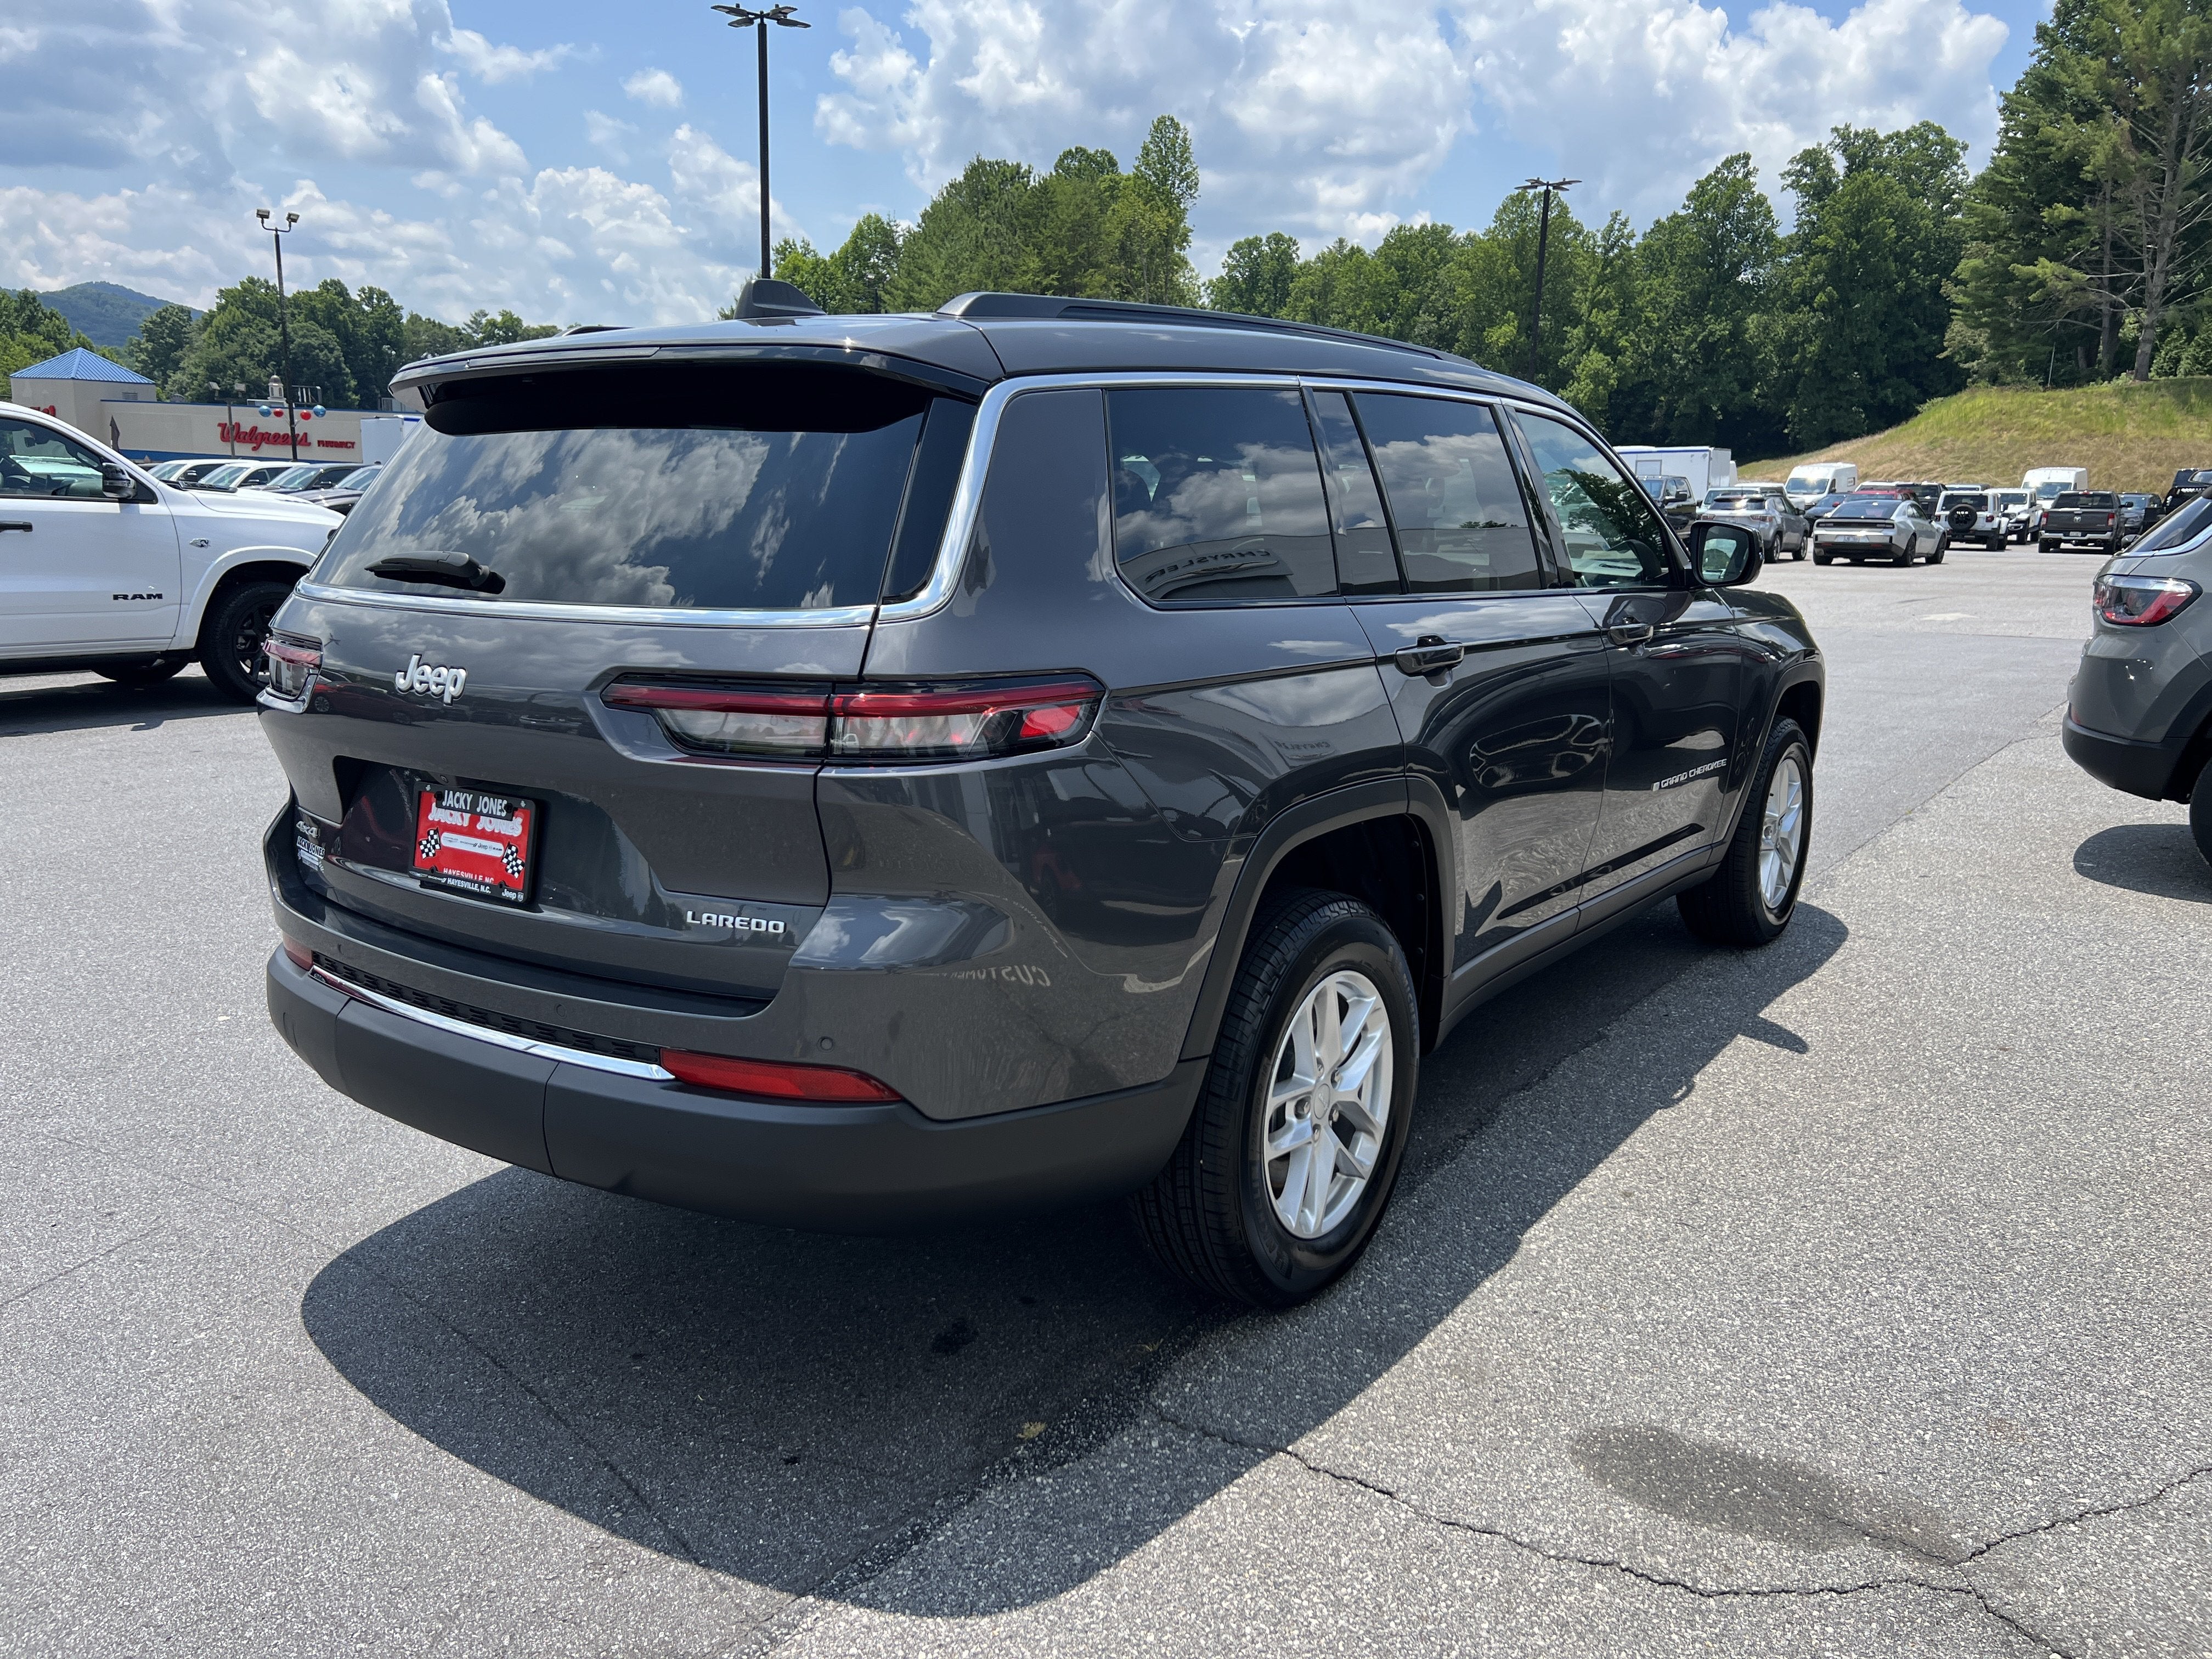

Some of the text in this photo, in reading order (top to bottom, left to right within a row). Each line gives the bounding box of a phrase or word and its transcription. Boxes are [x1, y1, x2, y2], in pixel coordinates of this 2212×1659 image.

[396, 653, 467, 707] Jeep
[1661, 758, 1728, 788] GRAND CHEROKEE
[442, 790, 507, 817] JACKY JONES
[428, 803, 523, 837] JACKY JONES
[443, 867, 483, 882] HAYESVILLE
[447, 877, 479, 893] HAYESVILLE,
[480, 884, 491, 894] N.C.
[502, 889, 517, 900] Jeep
[686, 911, 787, 934] LAREDO
